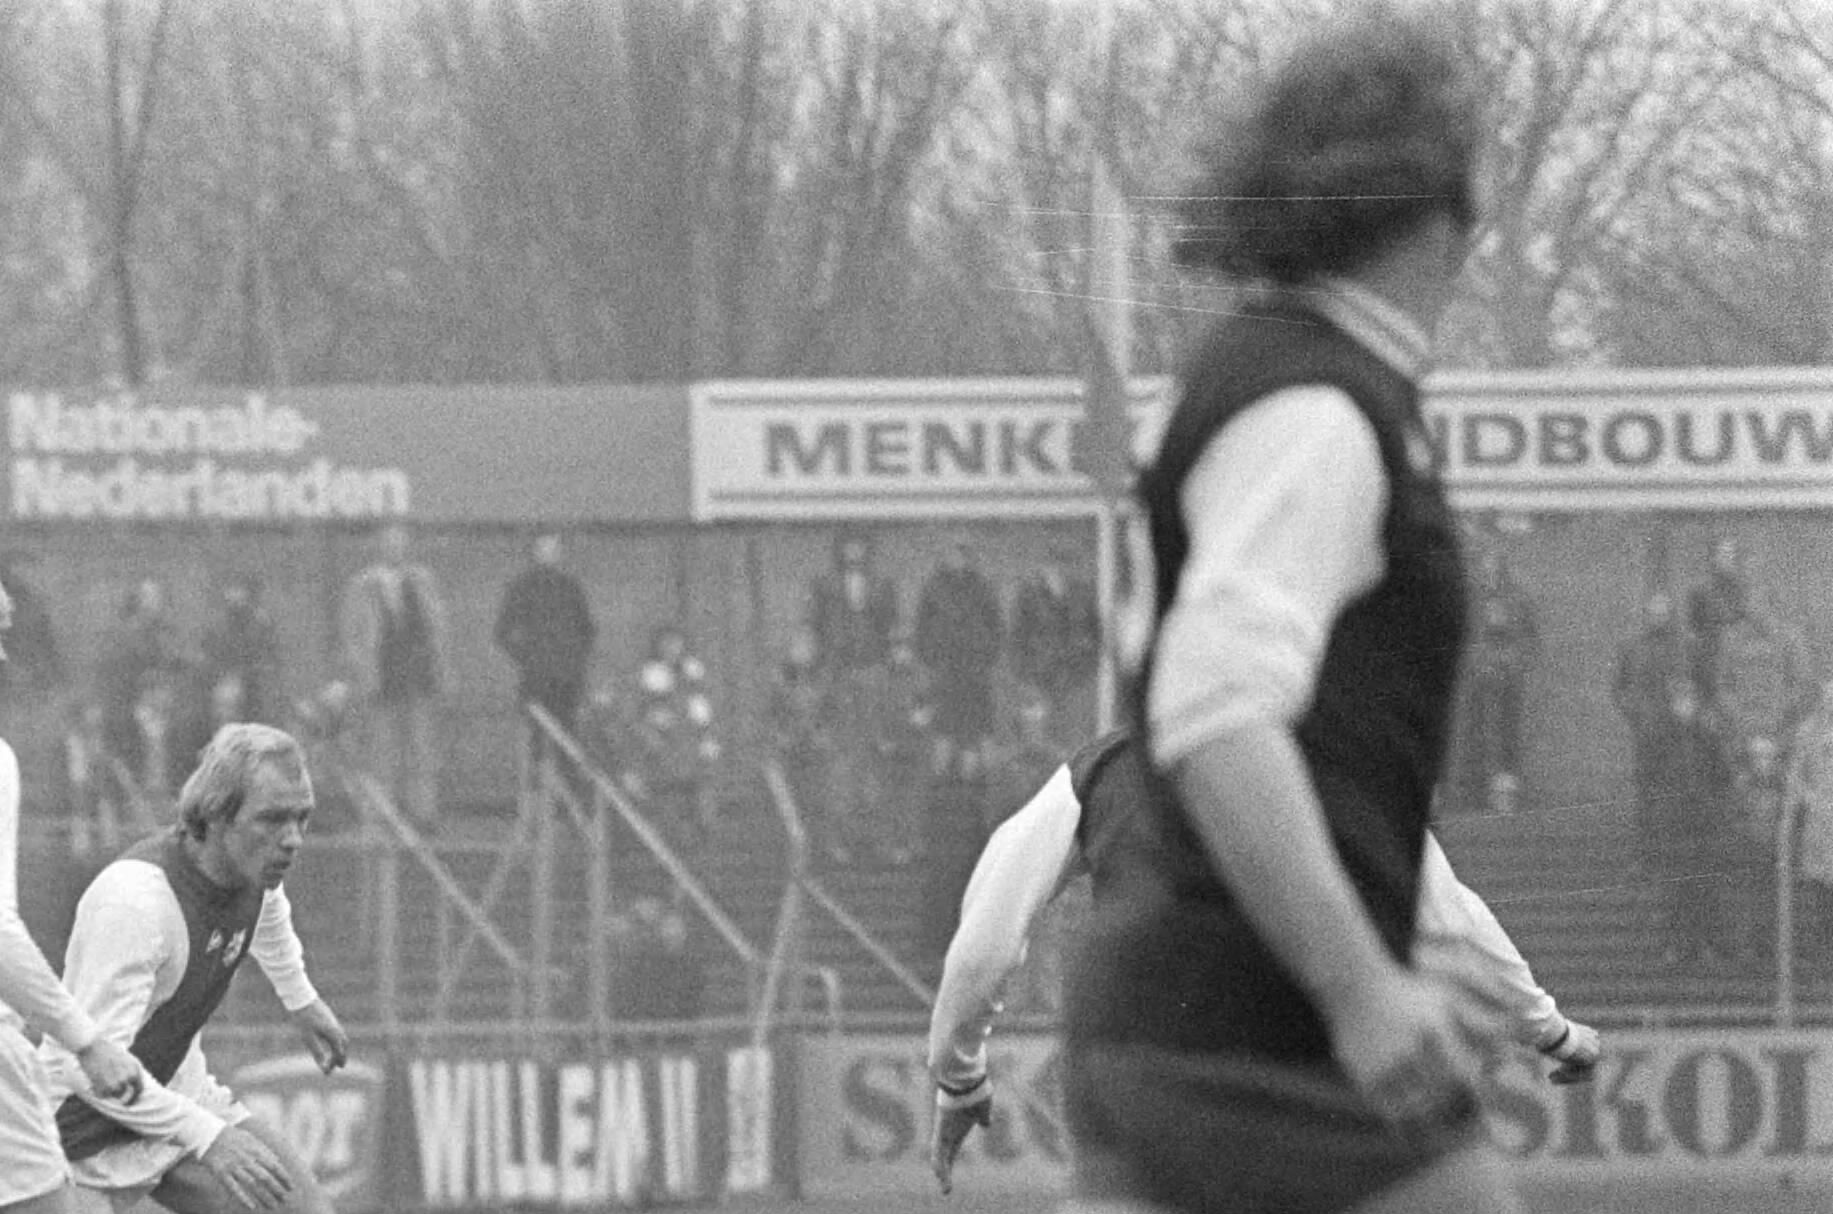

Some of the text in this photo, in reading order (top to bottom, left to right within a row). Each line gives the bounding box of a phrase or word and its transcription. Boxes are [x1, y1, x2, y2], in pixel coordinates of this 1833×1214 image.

[766, 419, 1088, 477] MENK
[10, 457, 411, 517] Nederlanden
[409, 1057, 650, 1206] WILLEM
[660, 1055, 698, 1198] II
